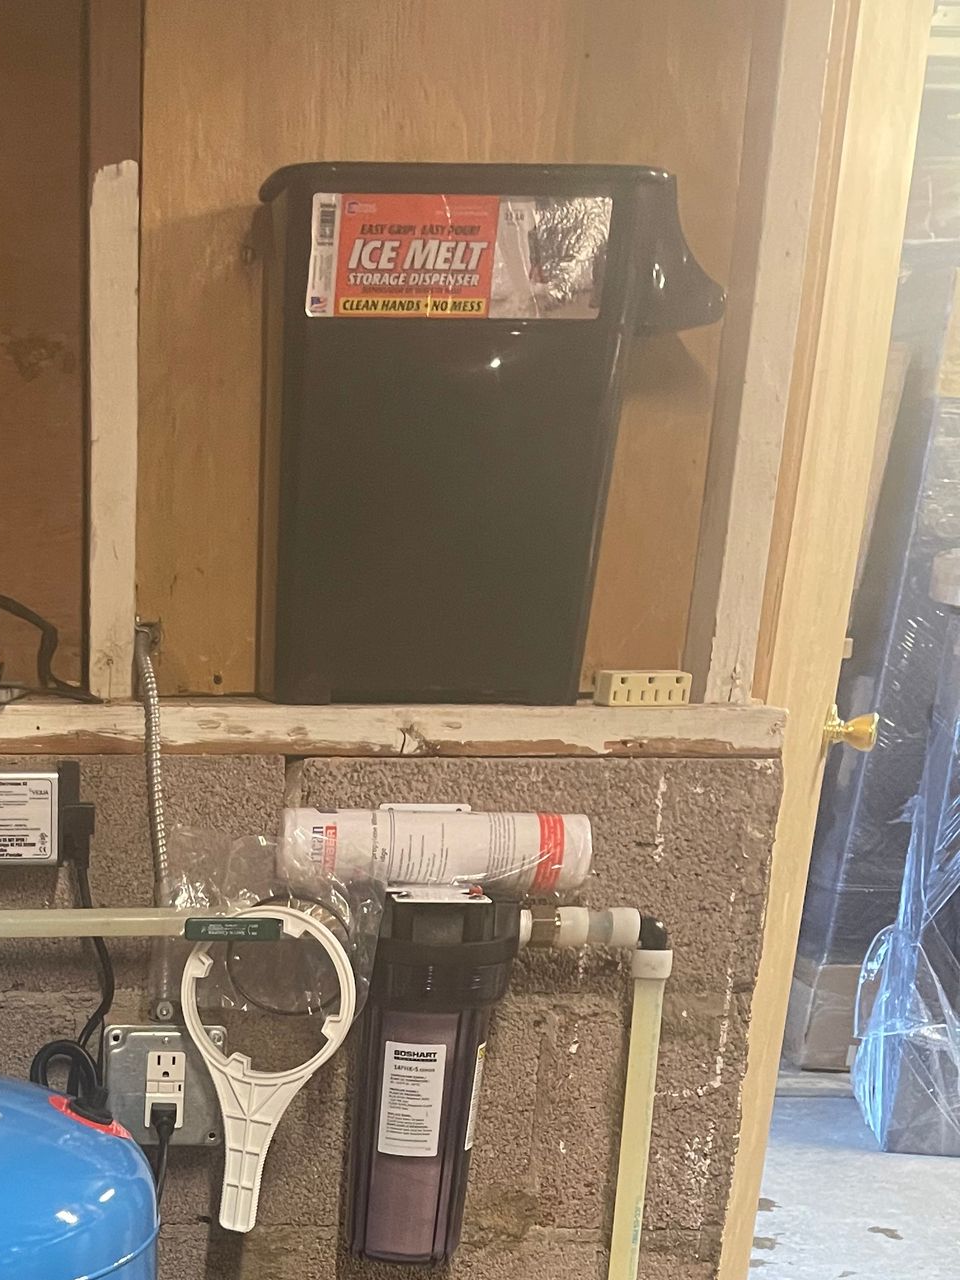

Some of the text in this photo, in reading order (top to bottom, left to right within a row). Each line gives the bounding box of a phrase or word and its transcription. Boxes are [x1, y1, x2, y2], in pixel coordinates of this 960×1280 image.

[360, 224, 386, 235] EASY
[421, 225, 447, 235] EASY
[348, 238, 488, 270] ICE MELT
[348, 272, 480, 287] STORAGE DISPENSER
[342, 299, 483, 312] CLEAN HANDS NO MESS
[394, 1050, 437, 1058] BOSHART
